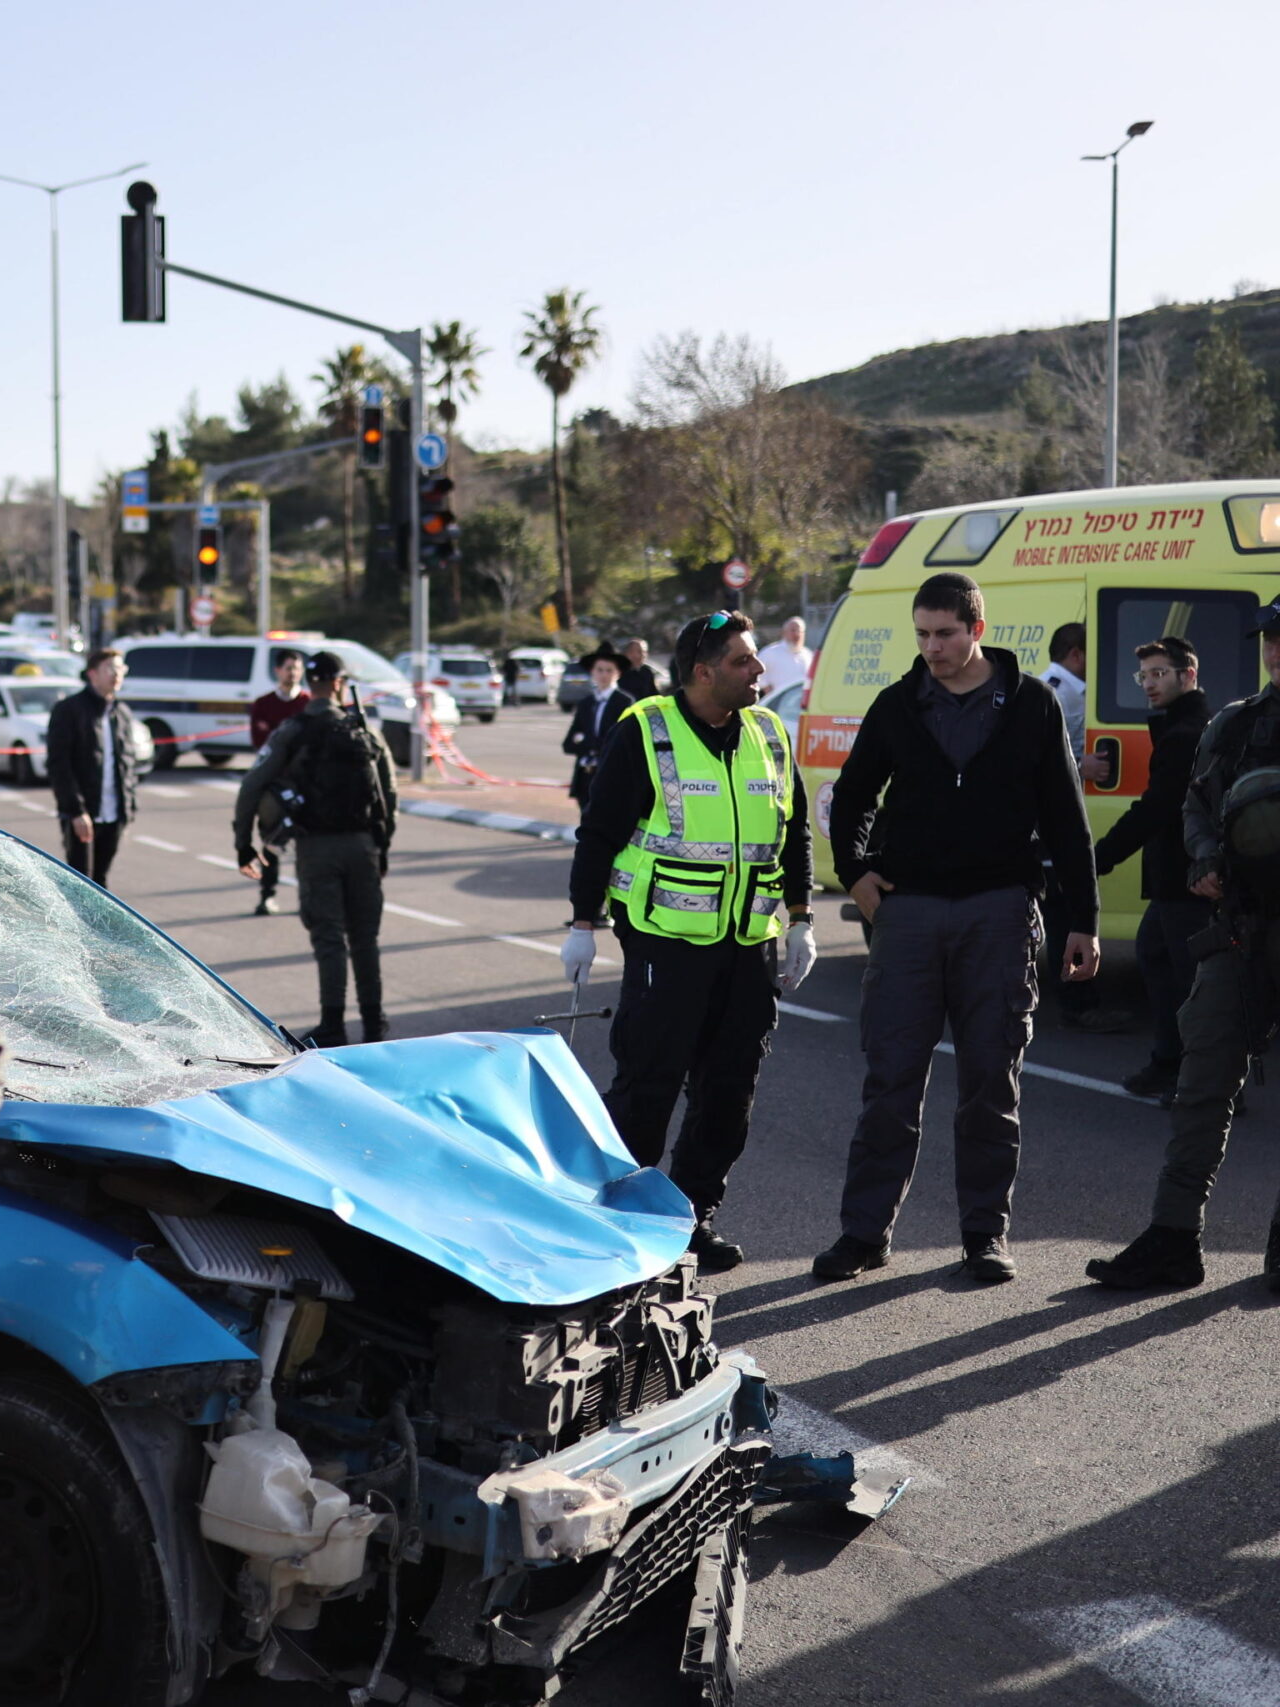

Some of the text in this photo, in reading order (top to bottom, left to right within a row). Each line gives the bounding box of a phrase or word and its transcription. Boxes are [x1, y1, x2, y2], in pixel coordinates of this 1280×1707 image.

[1024, 508, 1205, 543] ניידת טיפול נמרץ
[1013, 539, 1196, 567] MOBILE INTENSIVE CARE UNIT
[853, 628, 893, 641] MAGEN
[992, 625, 1045, 645] מגן דוד
[849, 643, 883, 656] DAVID
[847, 657, 880, 671] ADOM
[843, 672, 856, 685] IN
[682, 783, 718, 792] POLICE
